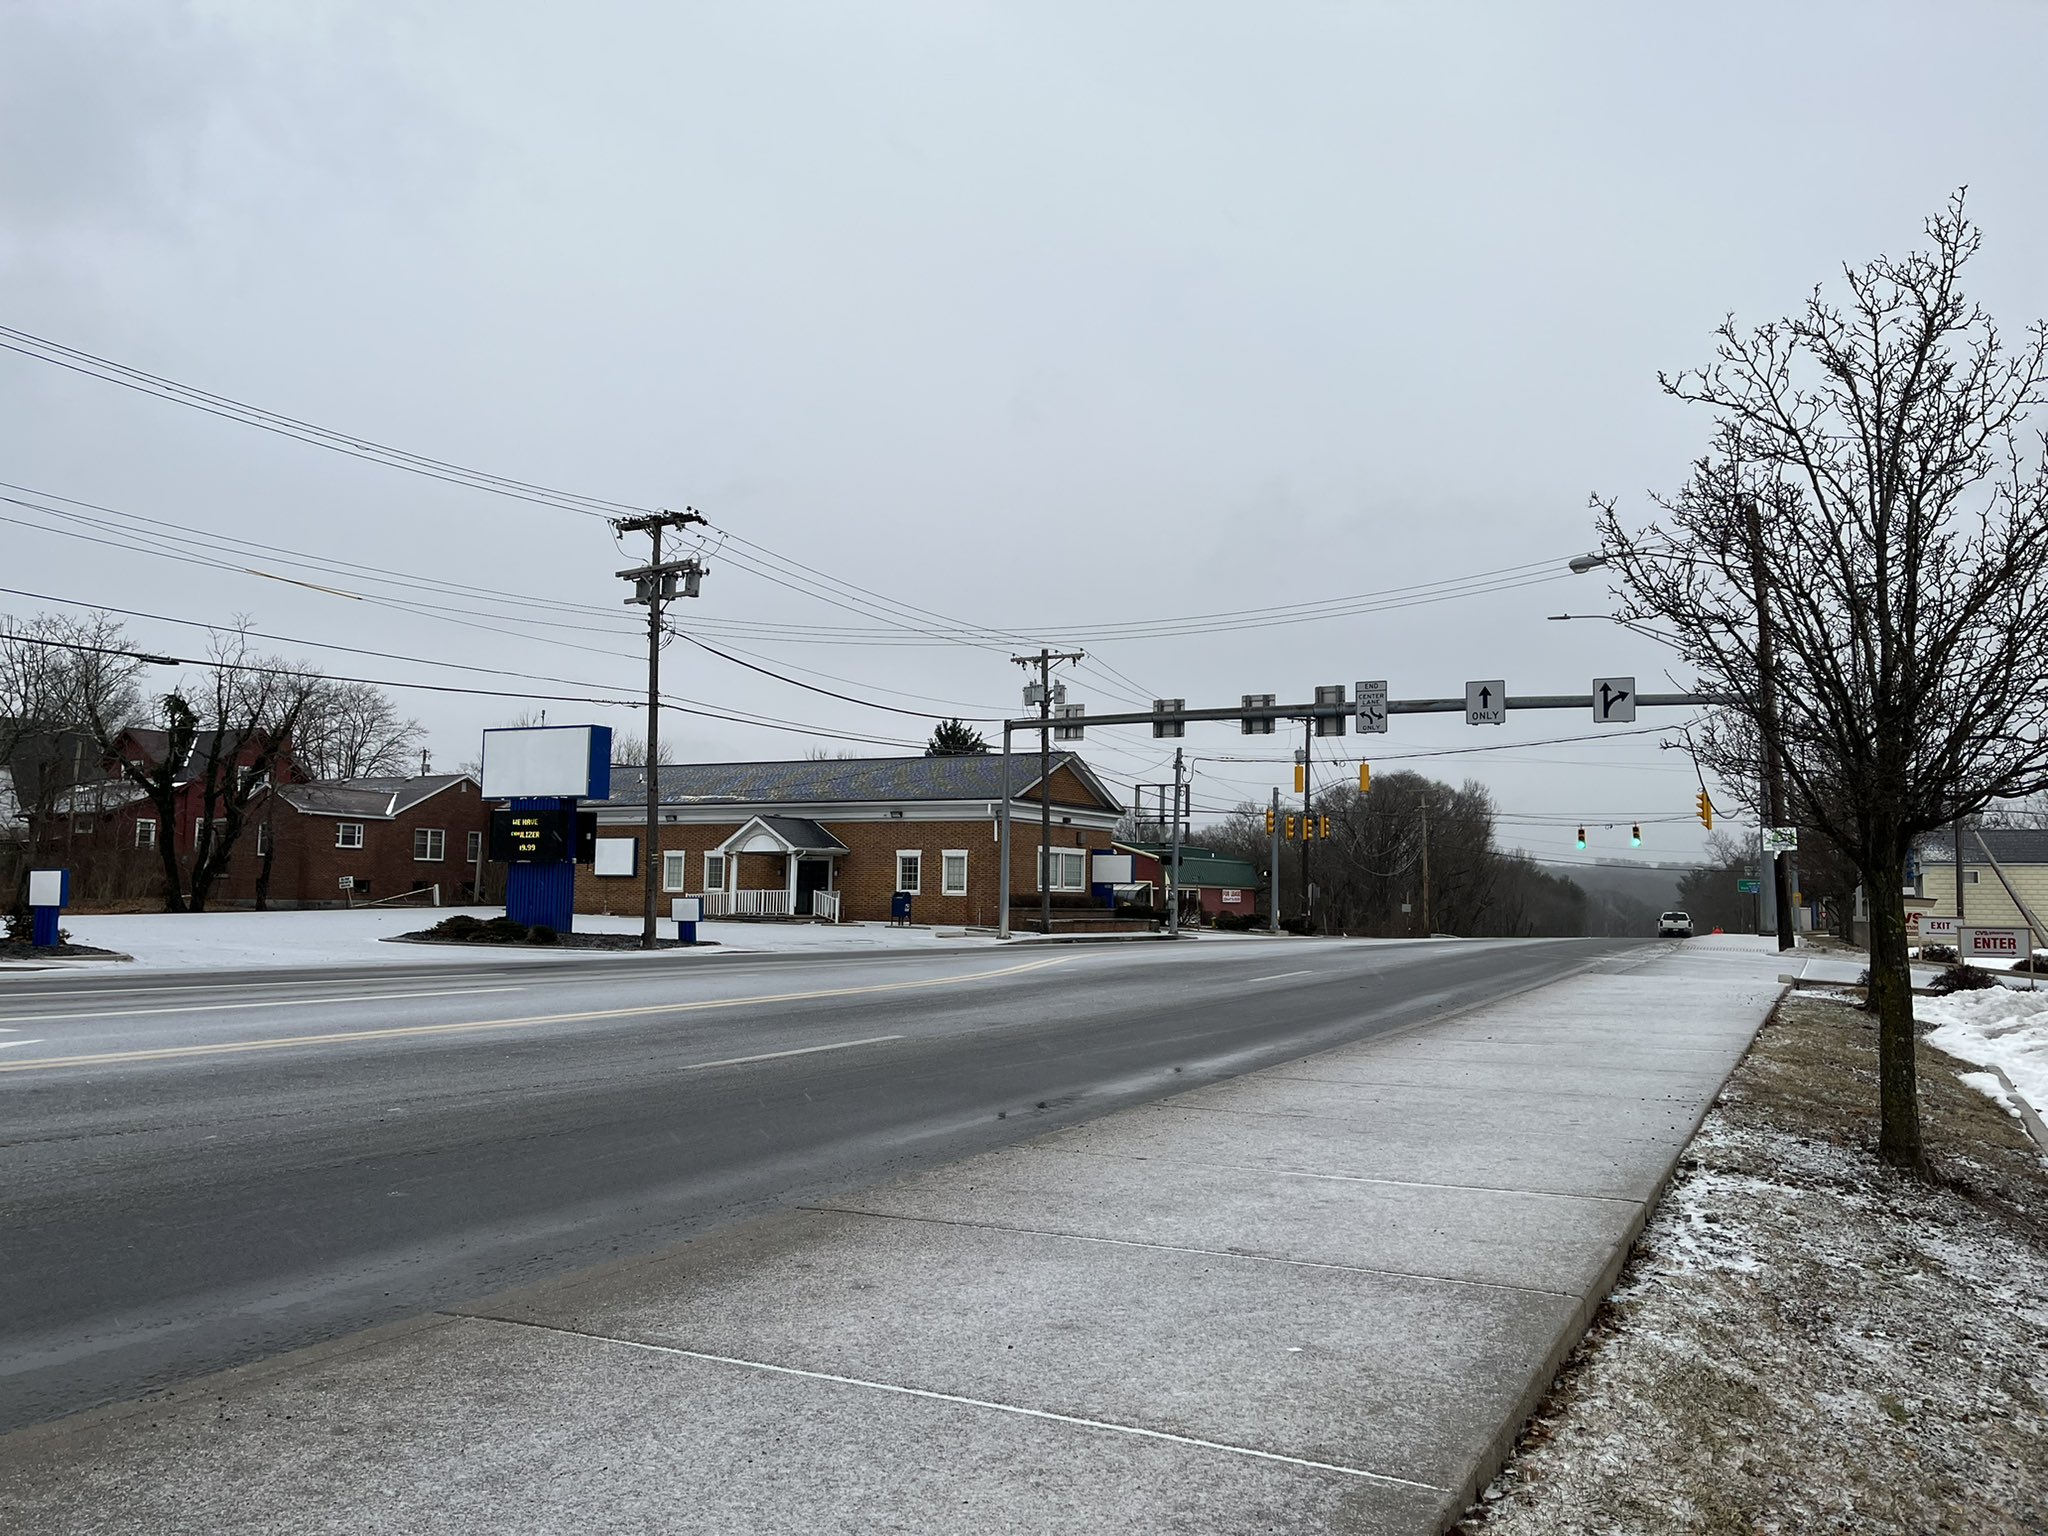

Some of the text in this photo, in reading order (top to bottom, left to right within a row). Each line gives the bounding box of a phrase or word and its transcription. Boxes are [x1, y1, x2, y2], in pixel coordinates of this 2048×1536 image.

[1471, 711, 1500, 720] ONLY
[522, 818, 539, 826] HAVE
[1905, 912, 1923, 924] VS
[1930, 921, 1951, 930] EXIT
[1973, 937, 2017, 949] ENTER
